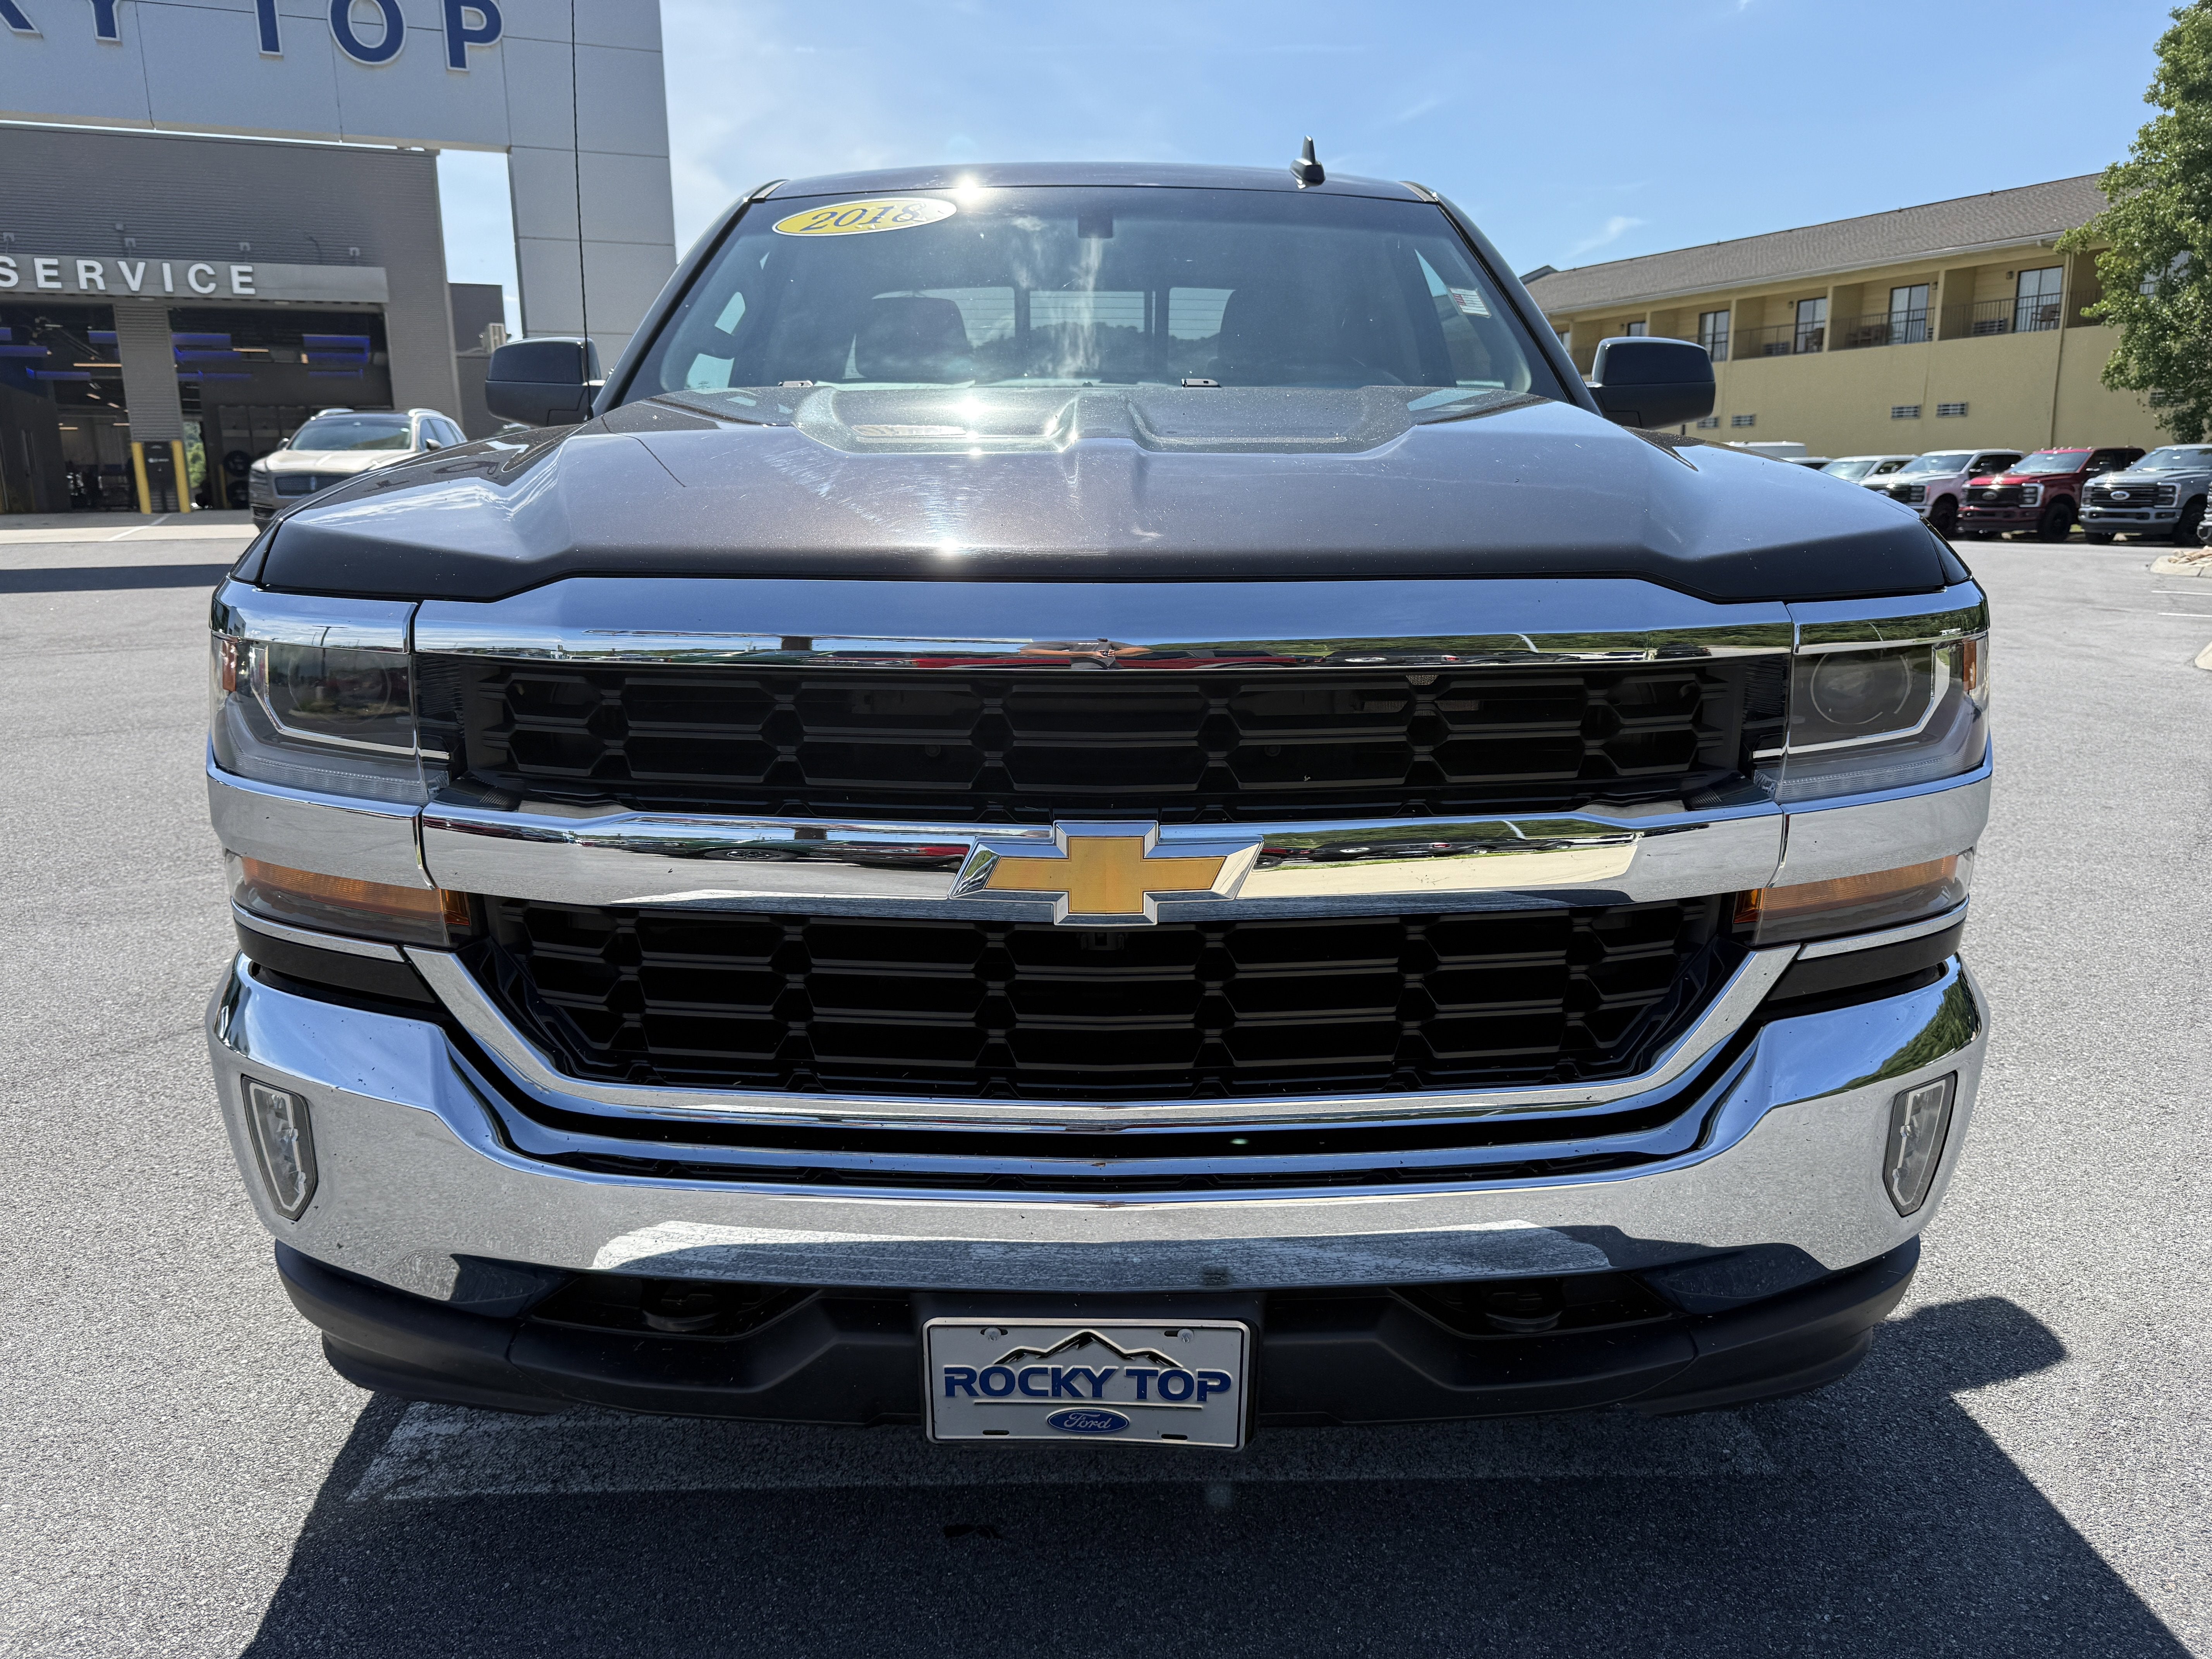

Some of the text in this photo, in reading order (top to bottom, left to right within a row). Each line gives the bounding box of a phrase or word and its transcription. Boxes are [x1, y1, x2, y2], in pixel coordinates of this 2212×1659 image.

[799, 203, 927, 232] 2018
[0, 256, 256, 295] SERVICE
[943, 1365, 1232, 1401] ROCKY TOP
[1064, 1413, 1112, 1429] Ford
